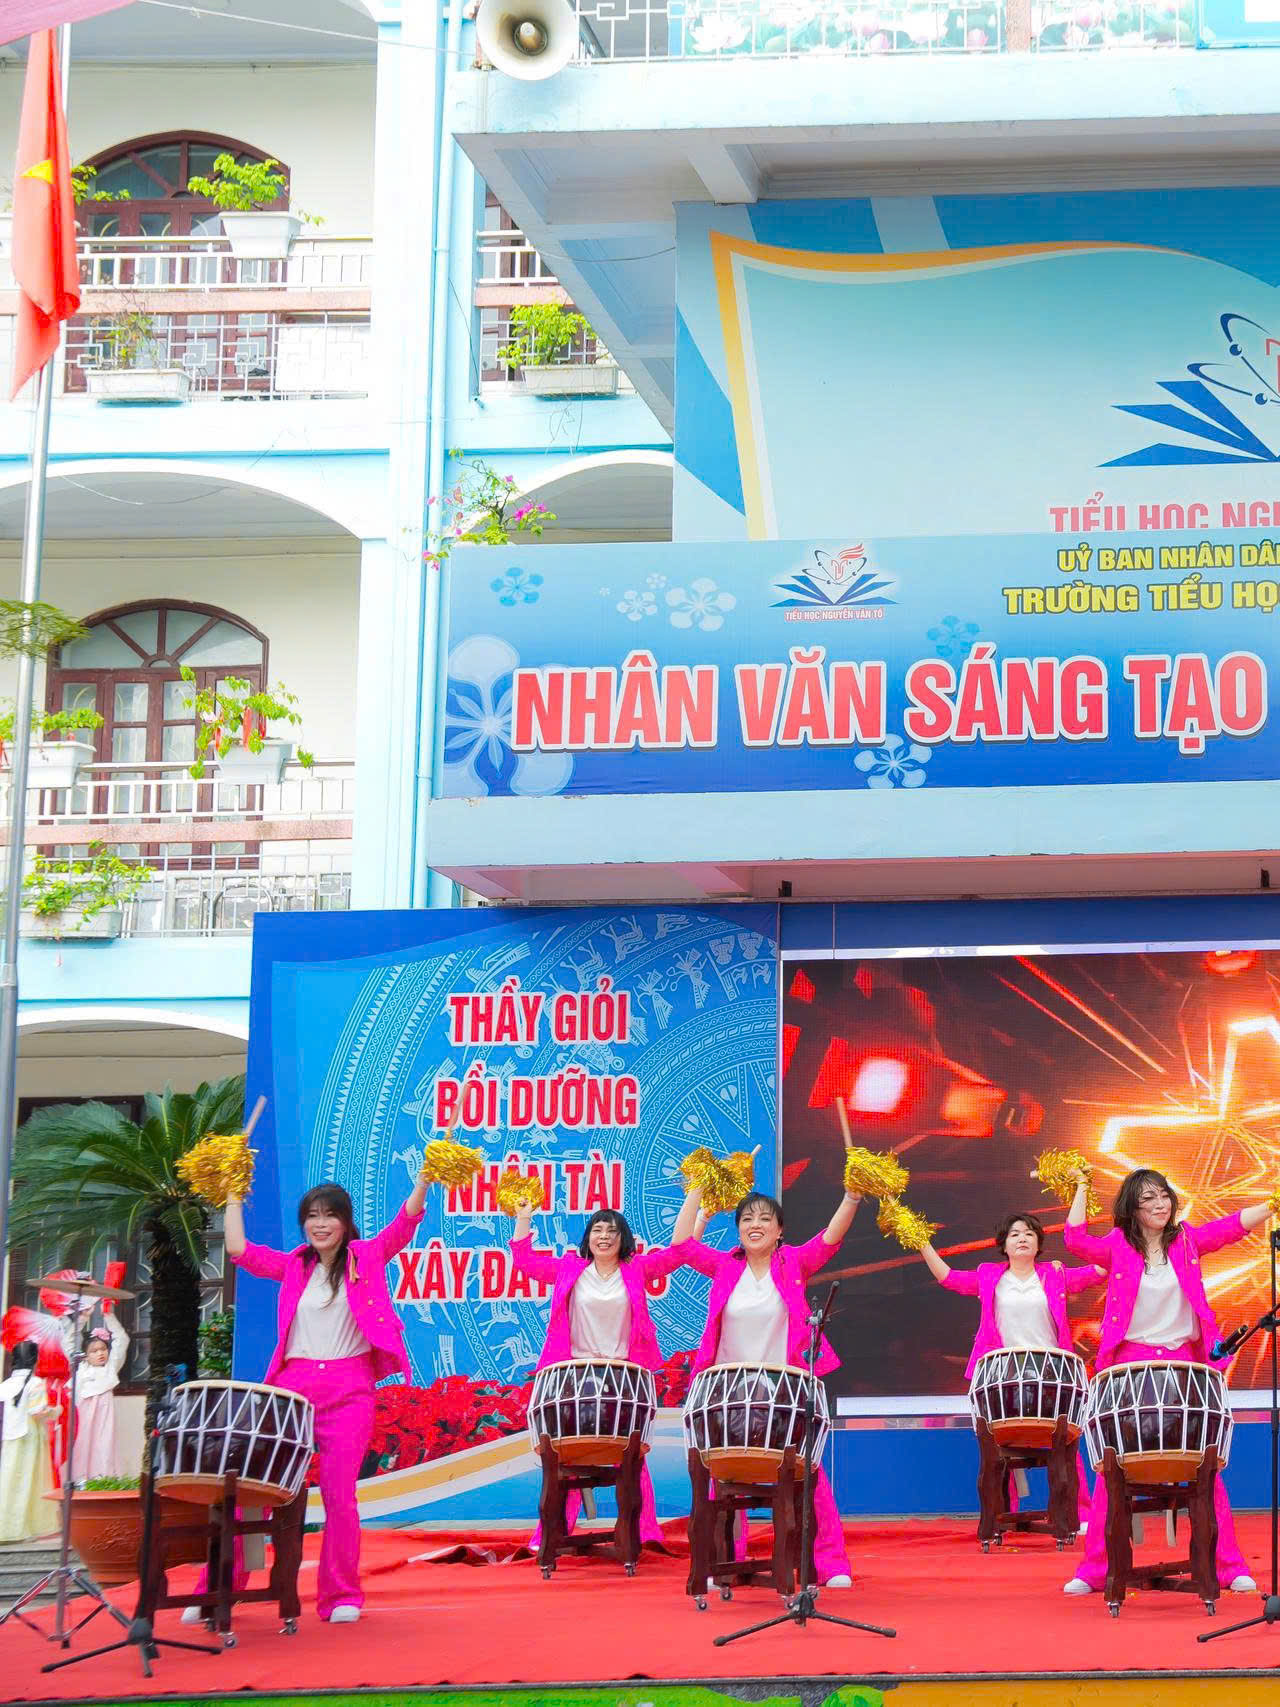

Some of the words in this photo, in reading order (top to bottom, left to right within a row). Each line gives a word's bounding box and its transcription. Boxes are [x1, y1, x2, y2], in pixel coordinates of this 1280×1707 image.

[1057, 542, 1093, 572] UỶ
[1098, 547, 1154, 571] BAN
[1159, 541, 1234, 570] NHÂN
[1003, 579, 1140, 615] TRƯỜNG
[1147, 572, 1223, 612] TIỂU
[511, 649, 720, 752] NHÂN
[735, 646, 889, 747] VĂN
[904, 642, 1108, 743] SÁNG
[1124, 650, 1267, 755] TẠO
[449, 977, 543, 1044] THẦY
[552, 977, 629, 1042] GIỎI
[435, 1062, 498, 1128] BỒI
[509, 1066, 638, 1127] DƯỠNG
[564, 1152, 622, 1211] TÀI
[399, 1240, 471, 1300] XÂY
